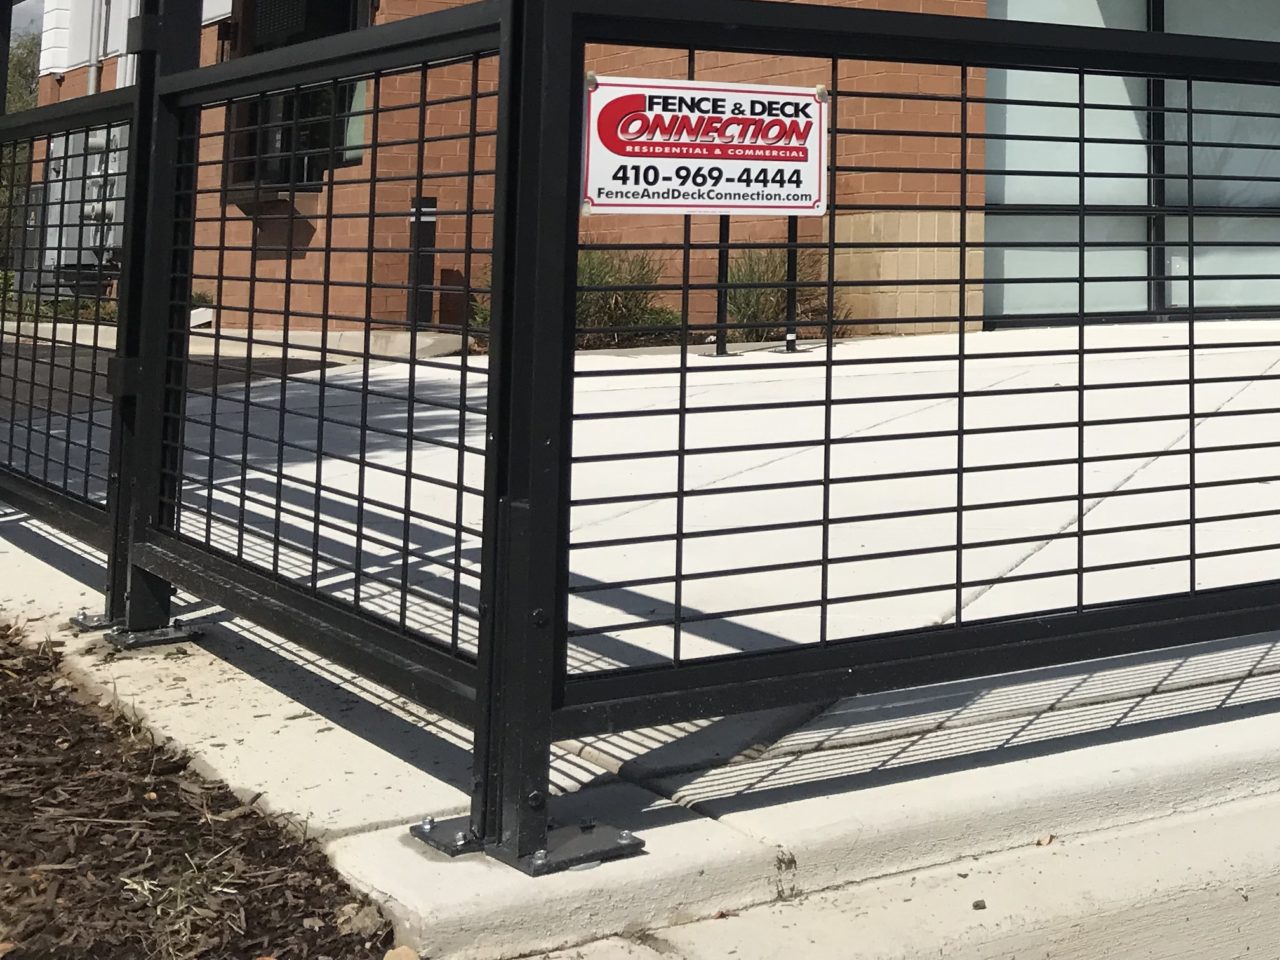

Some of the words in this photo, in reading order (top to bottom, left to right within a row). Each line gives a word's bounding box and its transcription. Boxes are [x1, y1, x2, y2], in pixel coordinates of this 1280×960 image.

[647, 94, 727, 116] FENCE
[731, 101, 747, 117] &
[749, 100, 814, 119] DECK
[597, 94, 814, 148] CONNECTION
[625, 144, 710, 156] RESIDENTIAL
[713, 146, 723, 156] &
[727, 147, 806, 159] COMMERCIAL
[611, 164, 804, 190] 410-969-4444
[596, 187, 813, 203] FenceAndDeckConnection.com
